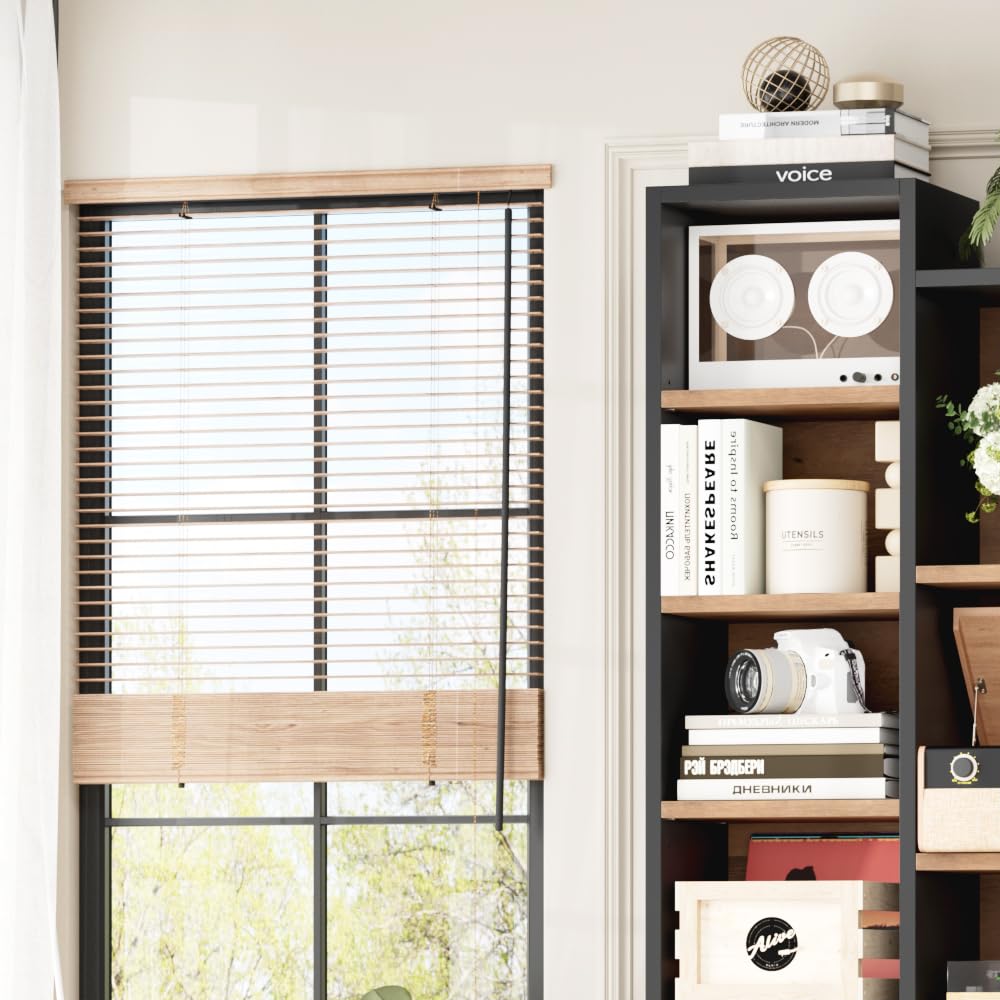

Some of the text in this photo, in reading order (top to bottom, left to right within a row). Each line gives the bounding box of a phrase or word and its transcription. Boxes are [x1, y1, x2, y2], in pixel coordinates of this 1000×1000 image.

[775, 166, 833, 183] voice
[782, 530, 824, 539] UTENSILS
[684, 756, 764, 776] РЭЙ БРЭДБЕРИ
[732, 784, 812, 796] ДНЕВНИКИ
[747, 928, 796, 960] Alive
